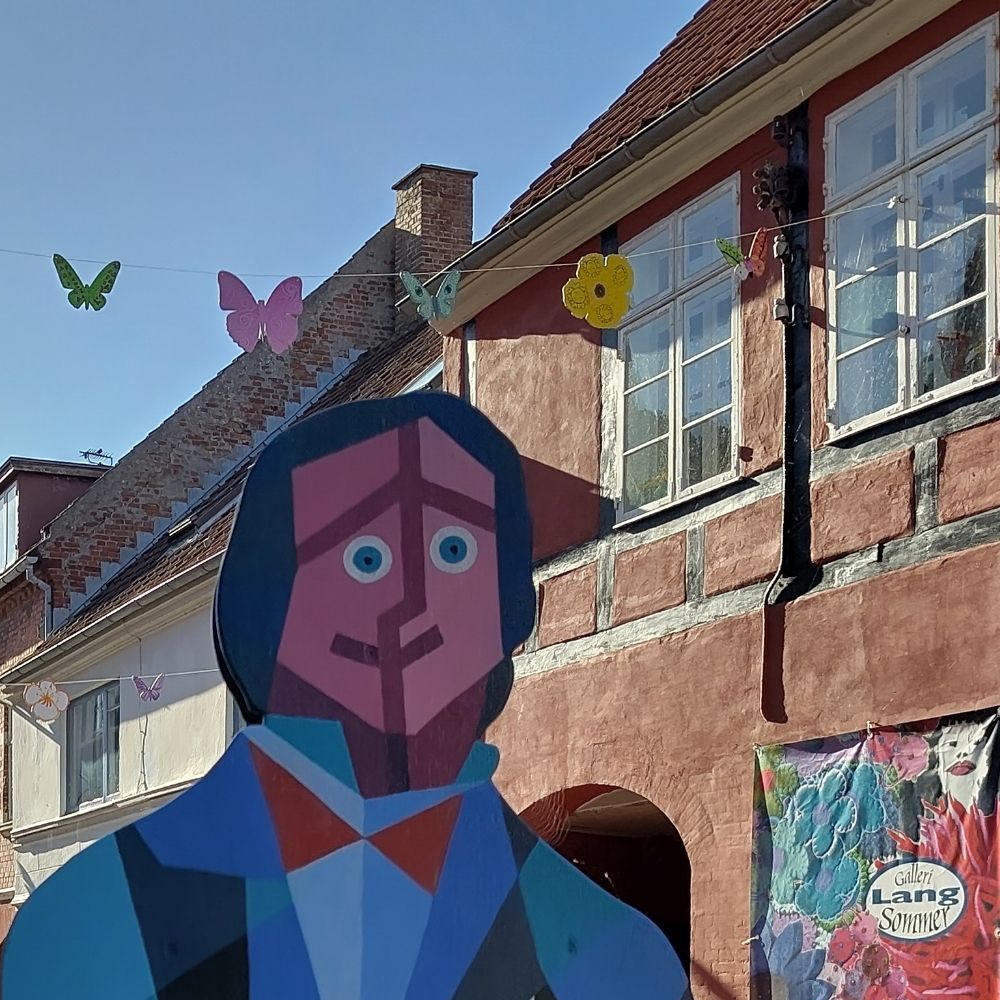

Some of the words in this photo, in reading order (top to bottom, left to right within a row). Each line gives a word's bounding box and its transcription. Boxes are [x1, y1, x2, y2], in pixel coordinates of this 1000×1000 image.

[894, 863, 934, 886] Galleri
[872, 886, 961, 906] Lang
[879, 906, 950, 934] Sommer
